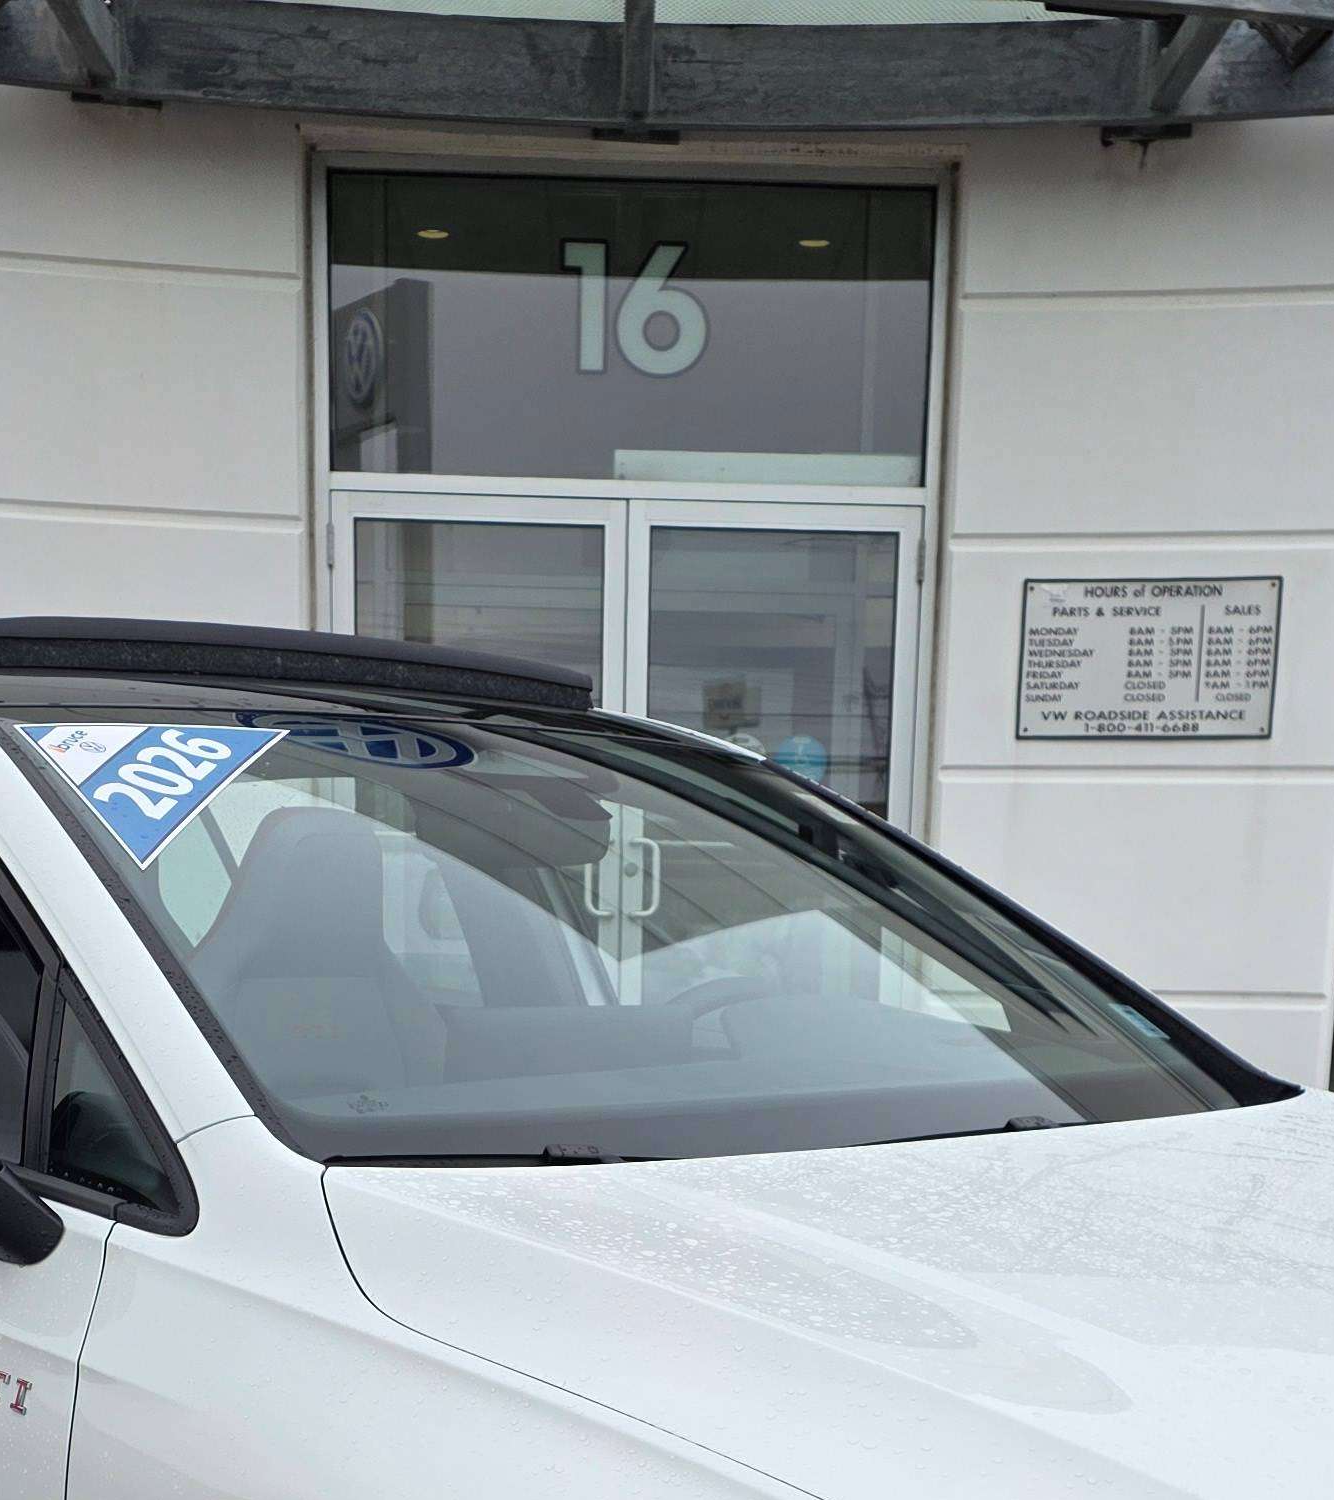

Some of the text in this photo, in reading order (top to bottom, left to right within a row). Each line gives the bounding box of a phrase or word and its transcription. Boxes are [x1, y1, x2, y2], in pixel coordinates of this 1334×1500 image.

[562, 239, 708, 377] 16
[1084, 584, 1224, 598] HOURS of OPERATION
[1052, 606, 1162, 617] PARTS & SERVICE
[1224, 604, 1261, 616] SALES
[1028, 627, 1078, 636] MONDAY
[1028, 638, 1075, 647] TUESDAY
[1027, 648, 1095, 658] WEDNESDAY
[1027, 659, 1082, 668] THURSDAY
[1026, 671, 1063, 679] FRIDAY
[1025, 681, 1166, 690] SATURDAY CLOSED
[1025, 692, 1166, 702] SUNDAY CLOSED
[1216, 692, 1252, 702] CLOSED
[1041, 709, 1246, 721] VW ROADSIDE ASSISTANCE
[1083, 722, 1200, 733] 1-800-411-6688
[94, 728, 232, 820] 2026
